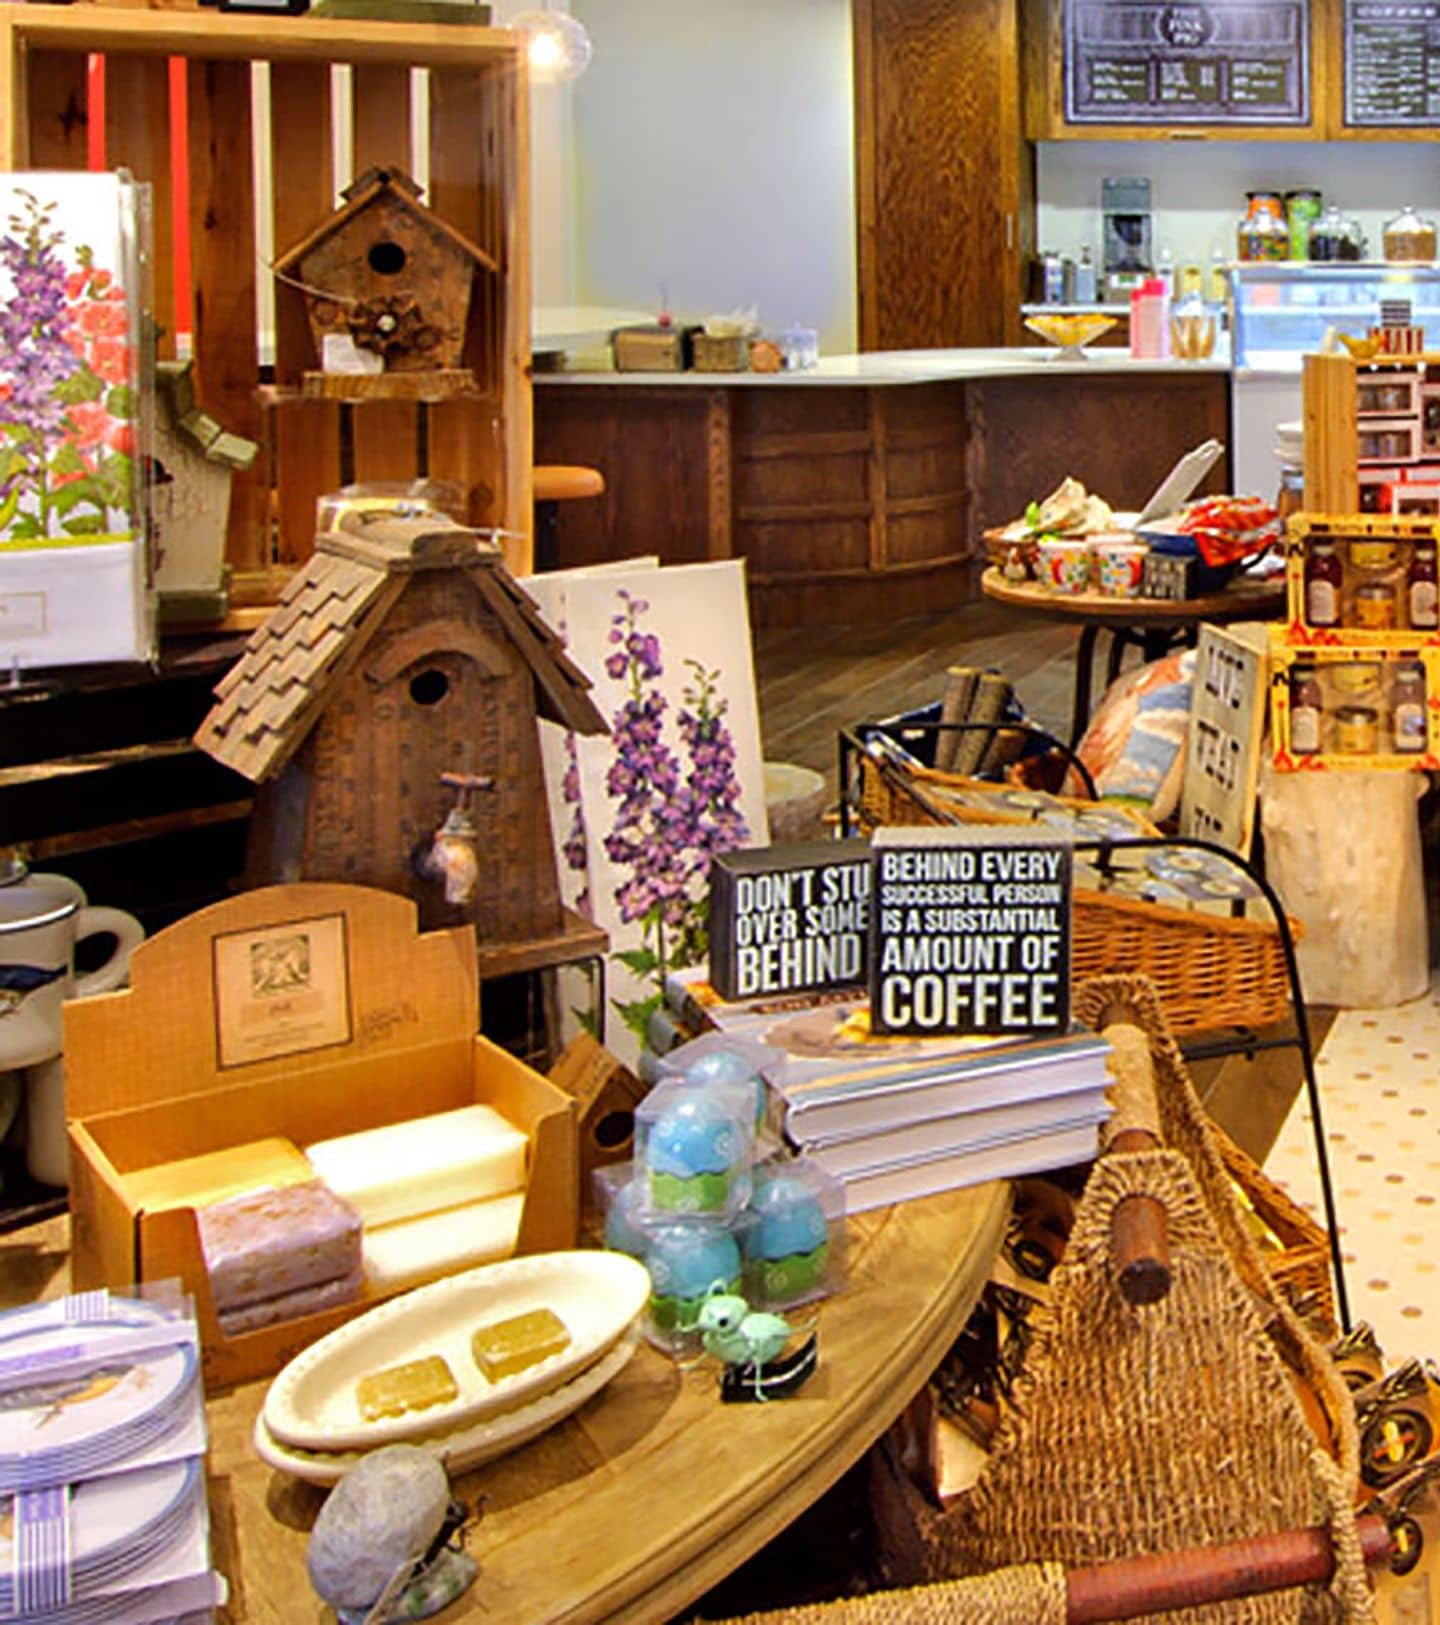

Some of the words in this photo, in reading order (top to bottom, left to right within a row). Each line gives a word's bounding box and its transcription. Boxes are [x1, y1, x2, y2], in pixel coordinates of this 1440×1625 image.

[881, 851, 975, 881] BEHIND
[981, 851, 1062, 881] EVERY
[736, 869, 814, 916] DON'T
[881, 884, 990, 906] SUCCESSFUL
[992, 884, 1062, 906] PERSON
[736, 908, 797, 946] OVER
[804, 902, 869, 937] SOME
[881, 909, 902, 934] IS
[905, 909, 922, 933] A
[924, 908, 1061, 934] SUBSTANTIAL
[737, 933, 862, 996] BEHIND
[881, 936, 1014, 973] AMOUNT
[1020, 936, 1061, 972] OF
[882, 974, 1060, 1029] COFFEE
